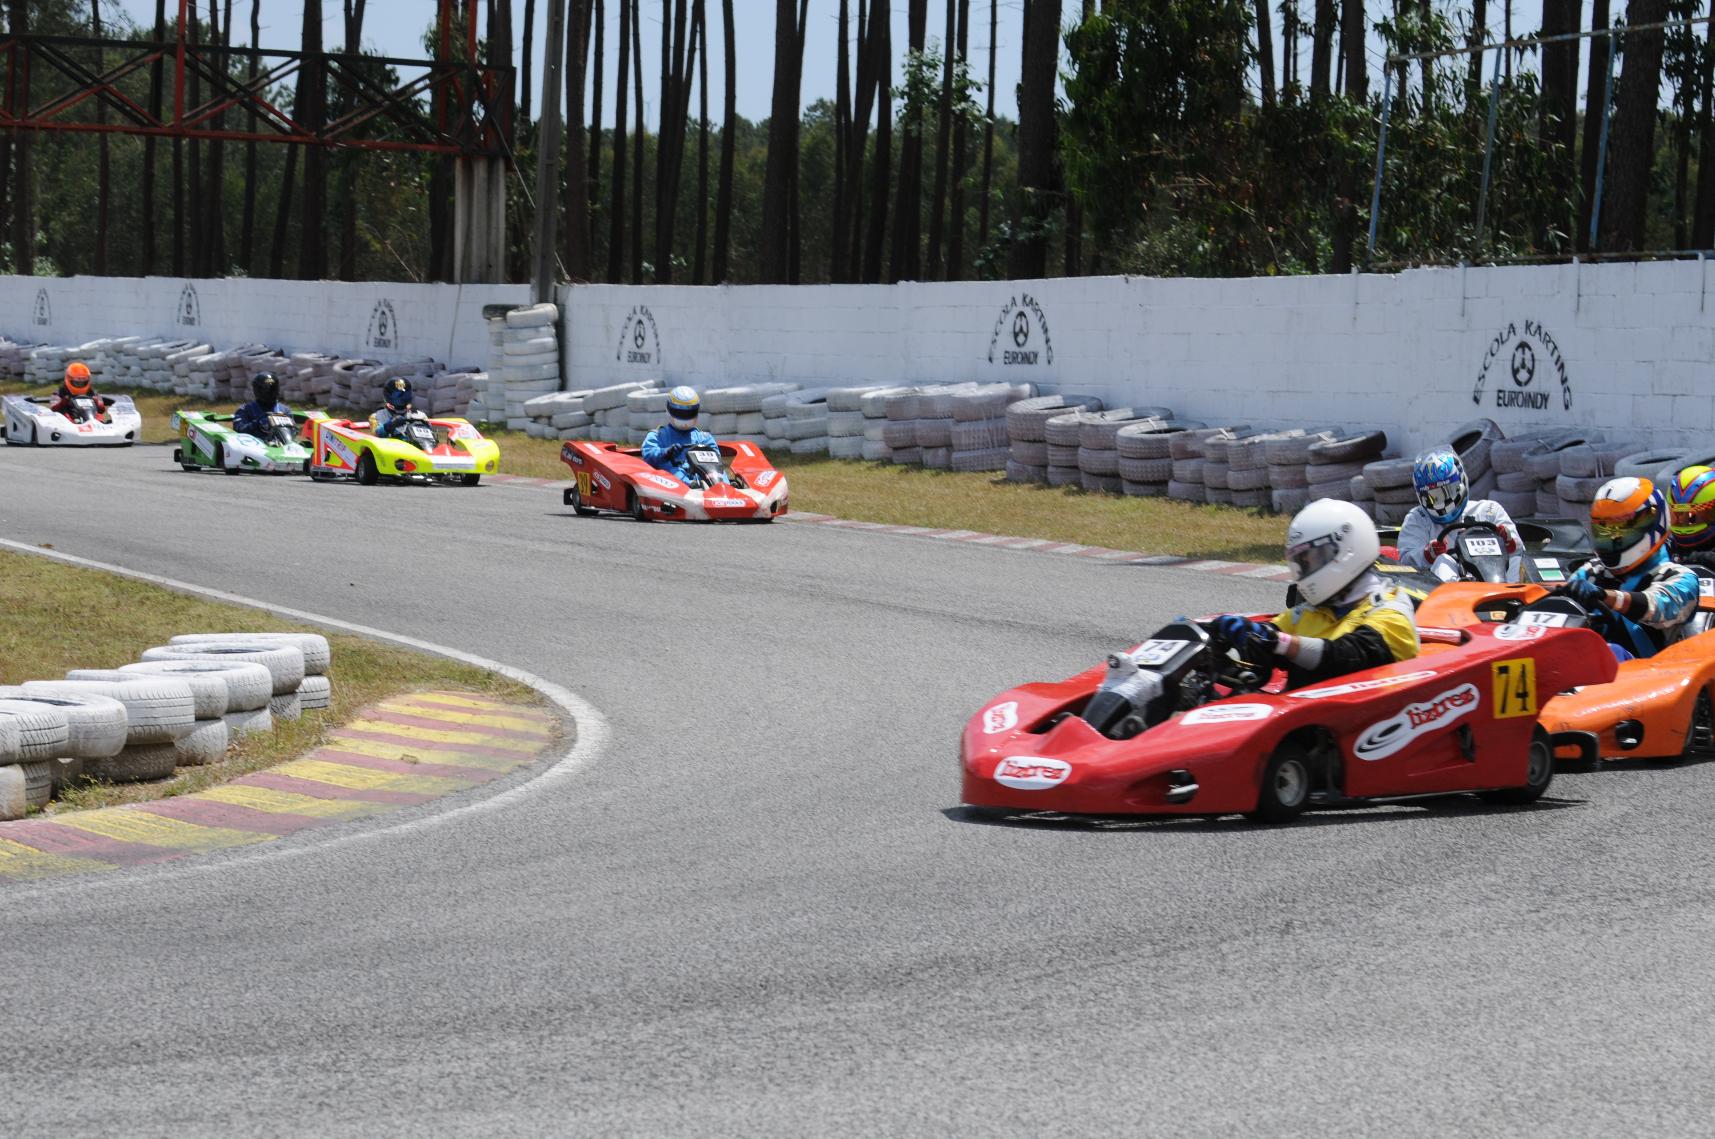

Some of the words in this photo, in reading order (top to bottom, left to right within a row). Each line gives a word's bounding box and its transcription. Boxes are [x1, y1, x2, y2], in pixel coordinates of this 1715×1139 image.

[1524, 319, 1573, 412] KARTING
[1496, 389, 1550, 410] EUROINDY
[1532, 612, 1558, 624] 17
[1497, 663, 1530, 715] 74
